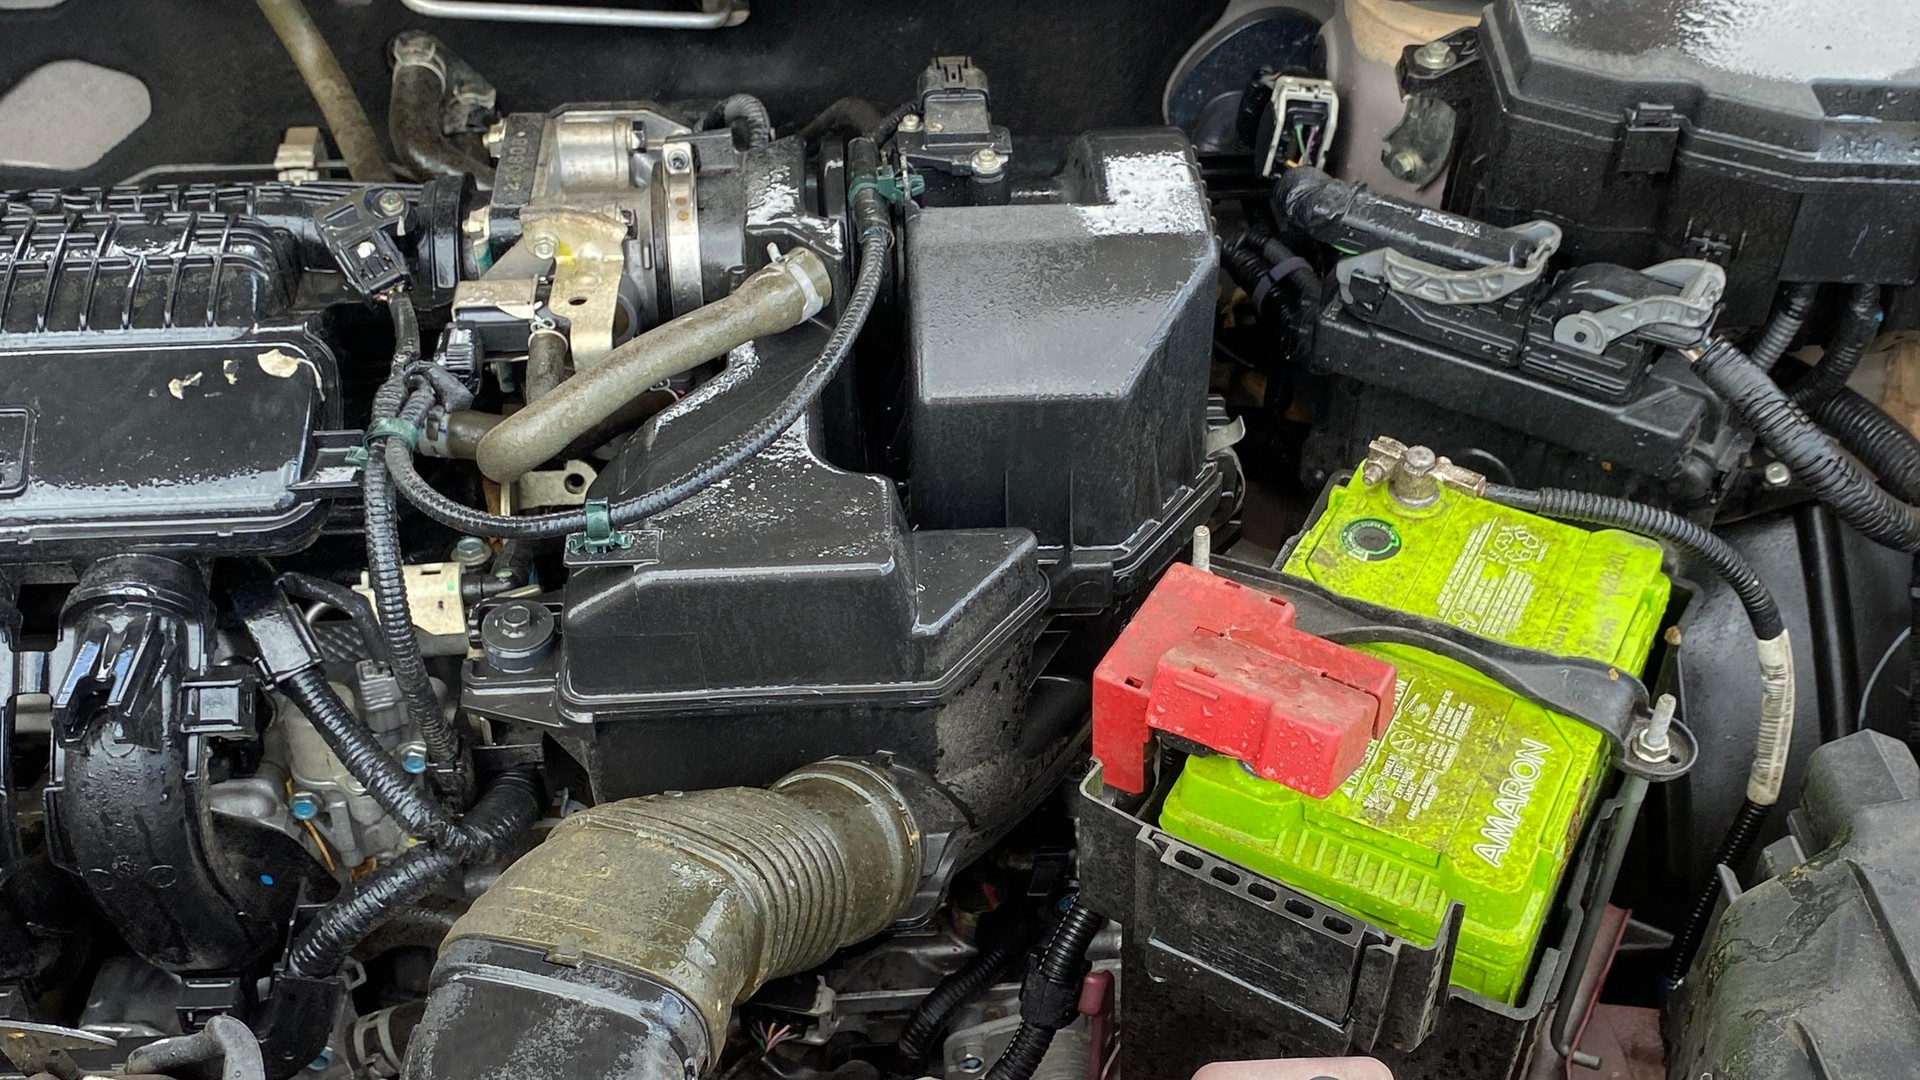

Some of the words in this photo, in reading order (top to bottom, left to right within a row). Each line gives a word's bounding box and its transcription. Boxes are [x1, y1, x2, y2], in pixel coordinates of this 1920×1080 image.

[1416, 741, 1428, 755] NO
[1349, 737, 1379, 785] DAGER
[1381, 753, 1397, 776] SHIELD
[1390, 763, 1404, 781] EYES
[1402, 780, 1418, 802] GASES
[1472, 740, 1551, 867] AMARON
